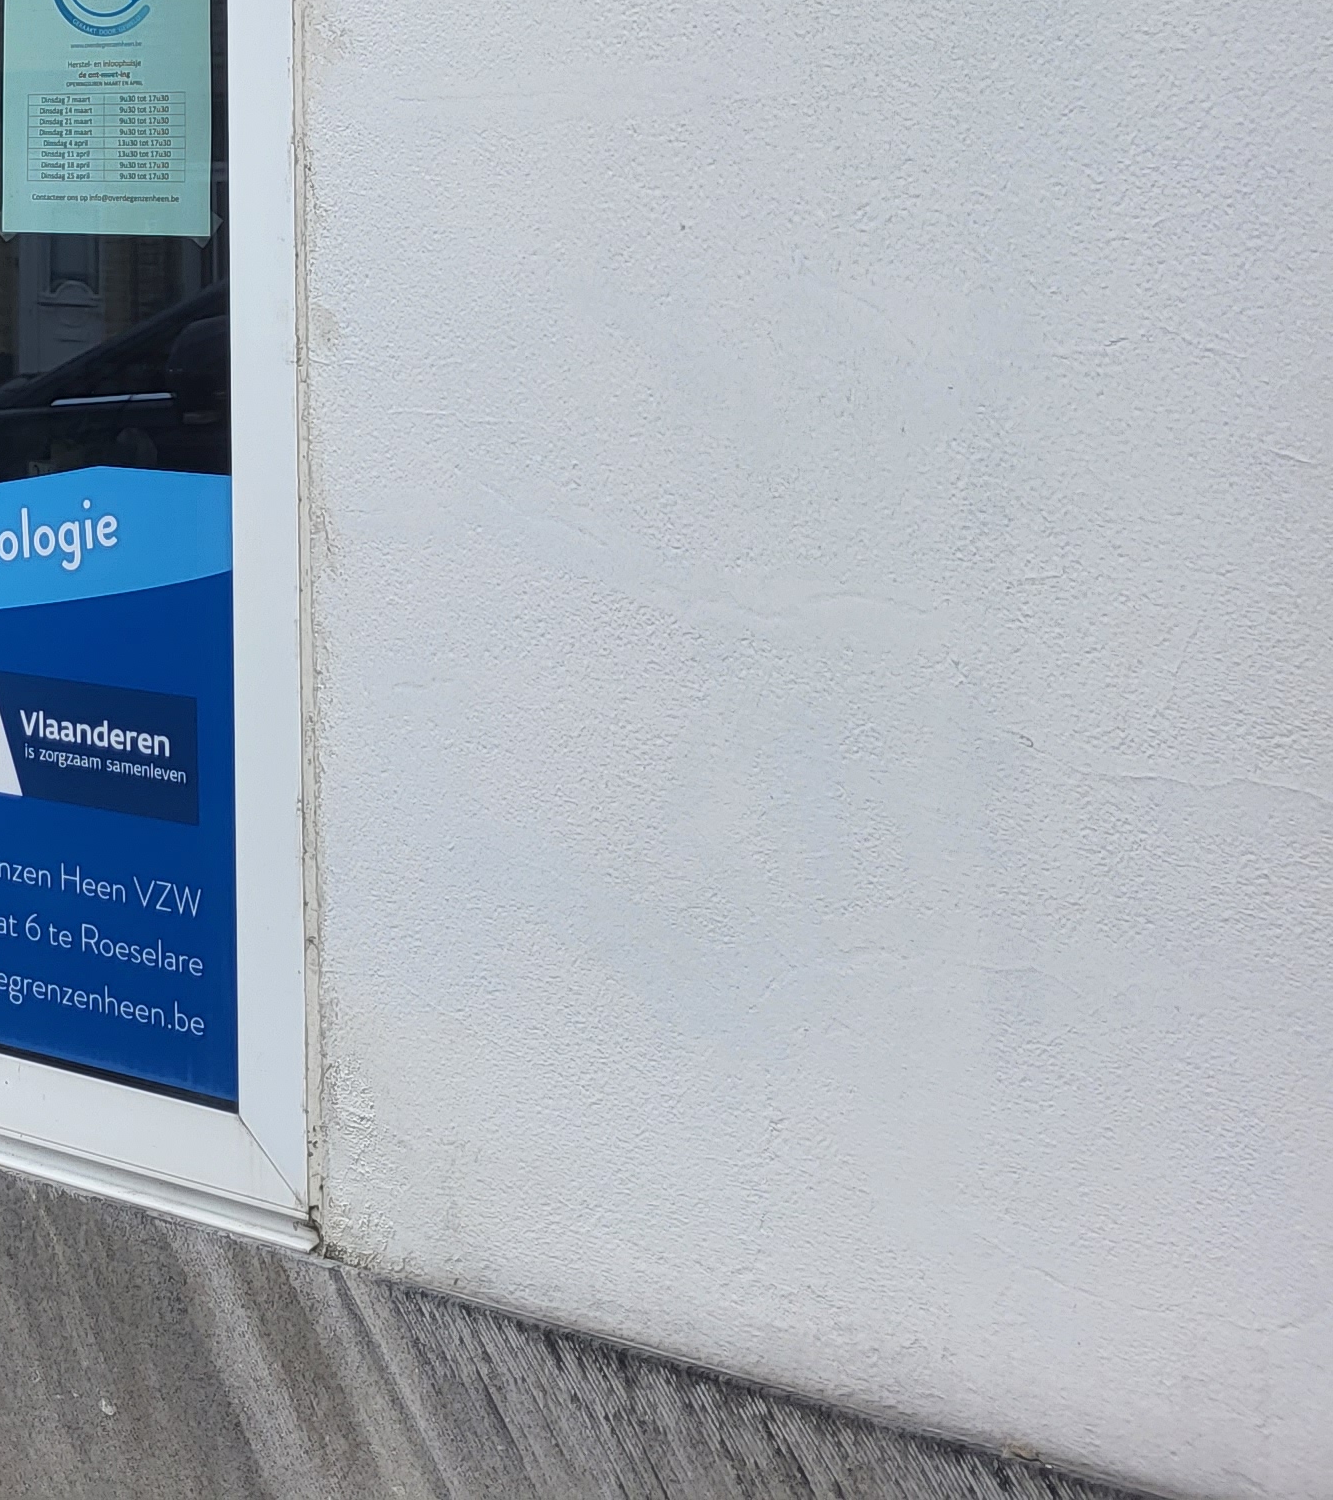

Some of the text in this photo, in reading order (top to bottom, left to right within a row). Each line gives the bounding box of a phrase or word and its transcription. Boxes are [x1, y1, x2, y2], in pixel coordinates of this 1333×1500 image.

[41, 97, 65, 105] Dinsdag
[40, 107, 63, 116] Dinsdag
[39, 118, 63, 126] Dinsdag
[39, 129, 63, 138] Dinsdag
[43, 140, 67, 148] Dinsdag
[74, 140, 88, 148] april
[41, 151, 65, 159] Dinsdag
[76, 151, 90, 159] april
[41, 162, 65, 170] Dinsdag
[76, 162, 90, 170] april
[41, 173, 65, 181] Dinsdag
[20, 709, 170, 757] Vlaanderen
[25, 744, 187, 785] is zorgzaam samenleven
[61, 863, 126, 904] Heen
[133, 876, 201, 918] VZW
[26, 914, 41, 941] 6
[49, 923, 72, 948] te
[82, 925, 204, 976] Roeselare
